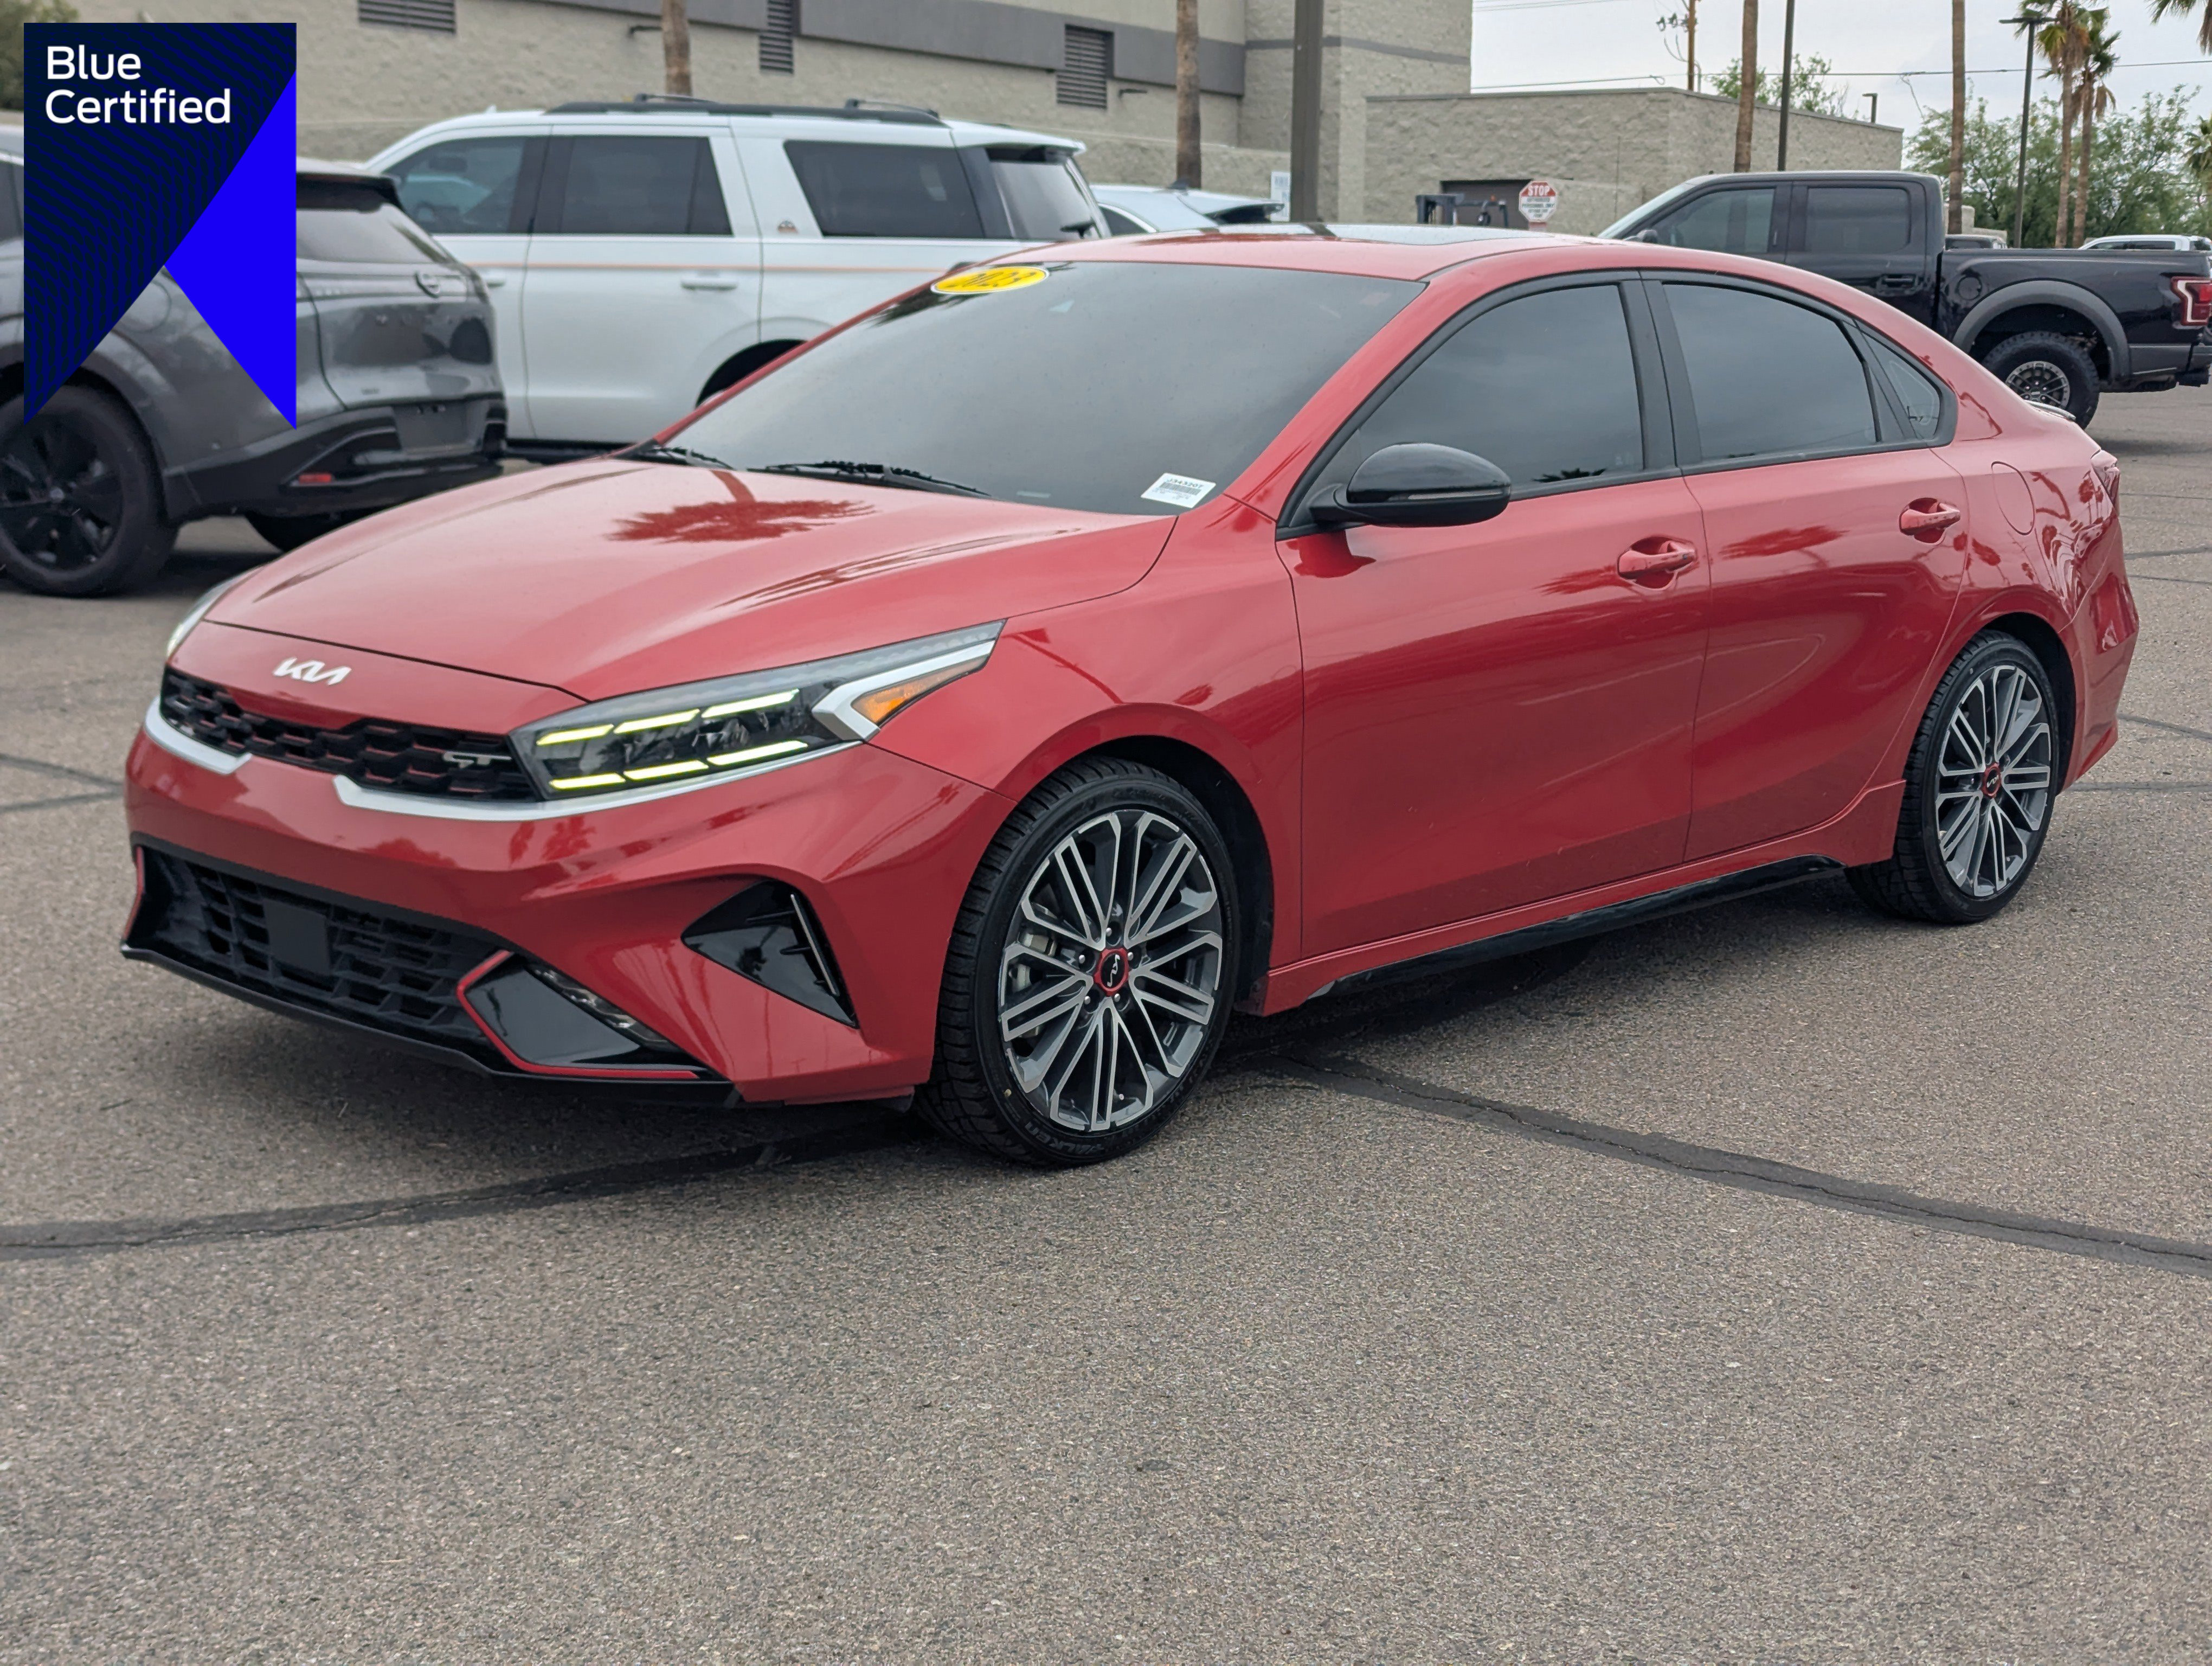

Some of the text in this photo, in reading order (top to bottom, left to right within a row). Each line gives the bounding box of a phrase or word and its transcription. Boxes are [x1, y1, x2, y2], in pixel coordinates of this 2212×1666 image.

[1528, 185, 1549, 196] STOP
[273, 656, 352, 685] KIA
[443, 751, 512, 768] GT
